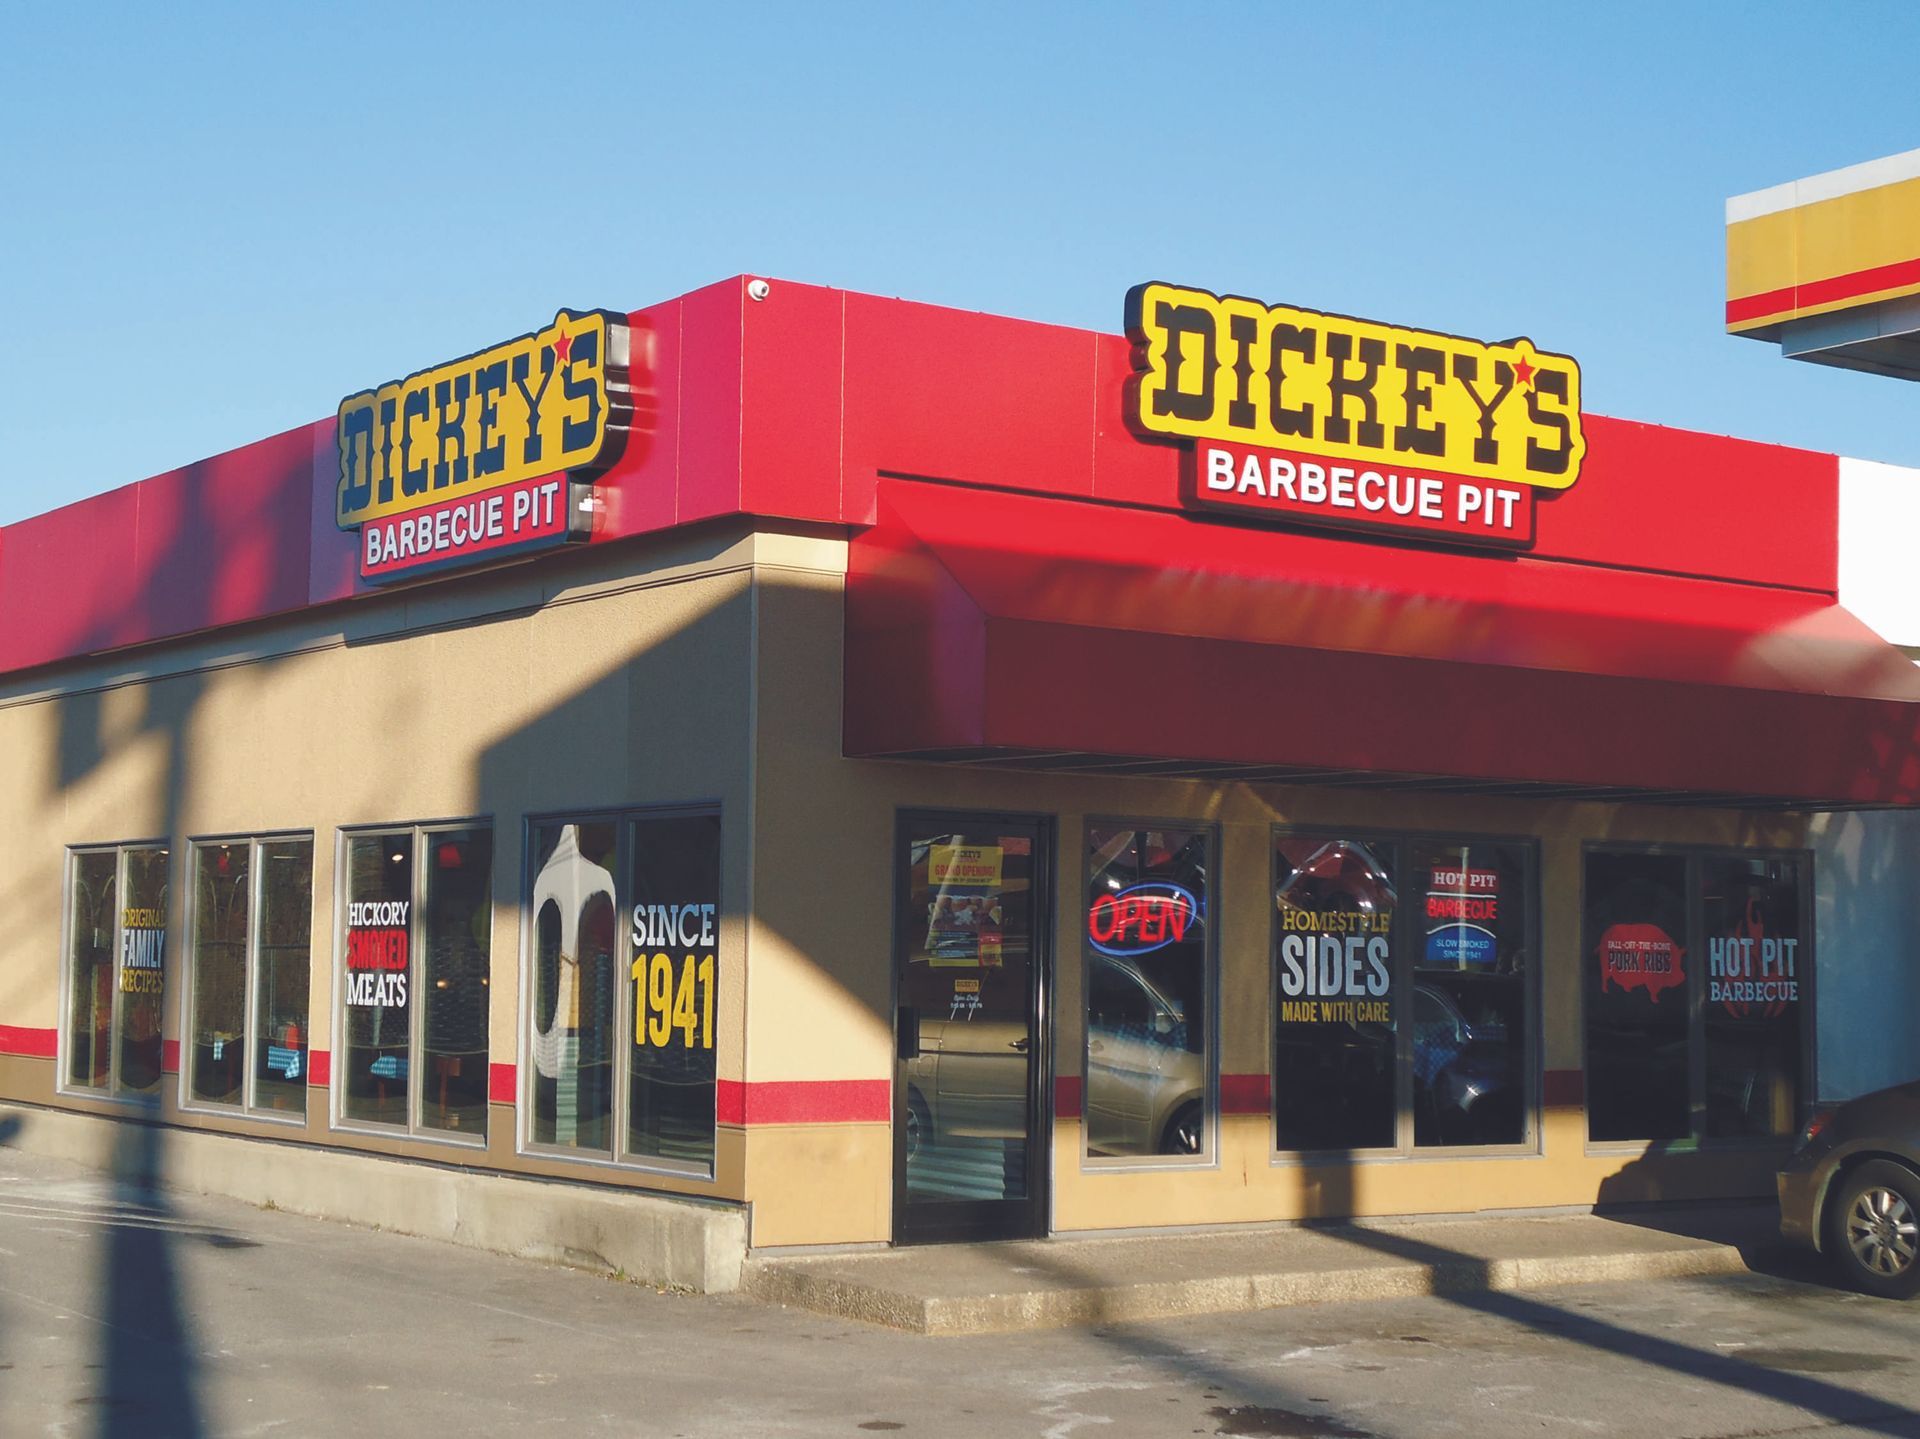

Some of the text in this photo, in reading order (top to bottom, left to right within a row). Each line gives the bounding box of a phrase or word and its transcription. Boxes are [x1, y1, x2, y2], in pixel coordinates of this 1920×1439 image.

[1207, 448, 1520, 528] BARBECUE PIT
[366, 481, 559, 566] BARBECUE PIT
[935, 864, 960, 876] GRAD
[1433, 871, 1497, 888] HOT PIT
[123, 908, 166, 928] ORIGINAL
[348, 901, 409, 926] HICKORY
[1089, 893, 1188, 943] OPEN
[1282, 909, 1390, 933] HOMESTYLE
[1426, 897, 1498, 920] BARBECUE
[632, 903, 715, 948] SINCE
[121, 929, 165, 968] FAMILY
[347, 929, 409, 970] SMOKED
[1609, 951, 1672, 974] PORK RIBS
[1709, 937, 1798, 977] HOT PIT
[121, 968, 164, 993] RECIPES
[1282, 934, 1390, 997] SIDES
[346, 973, 407, 1008] MEATS
[631, 953, 715, 1049] 1941
[1710, 981, 1799, 1002] BARBECUE
[1282, 1000, 1390, 1022] MADE WITH CARE
